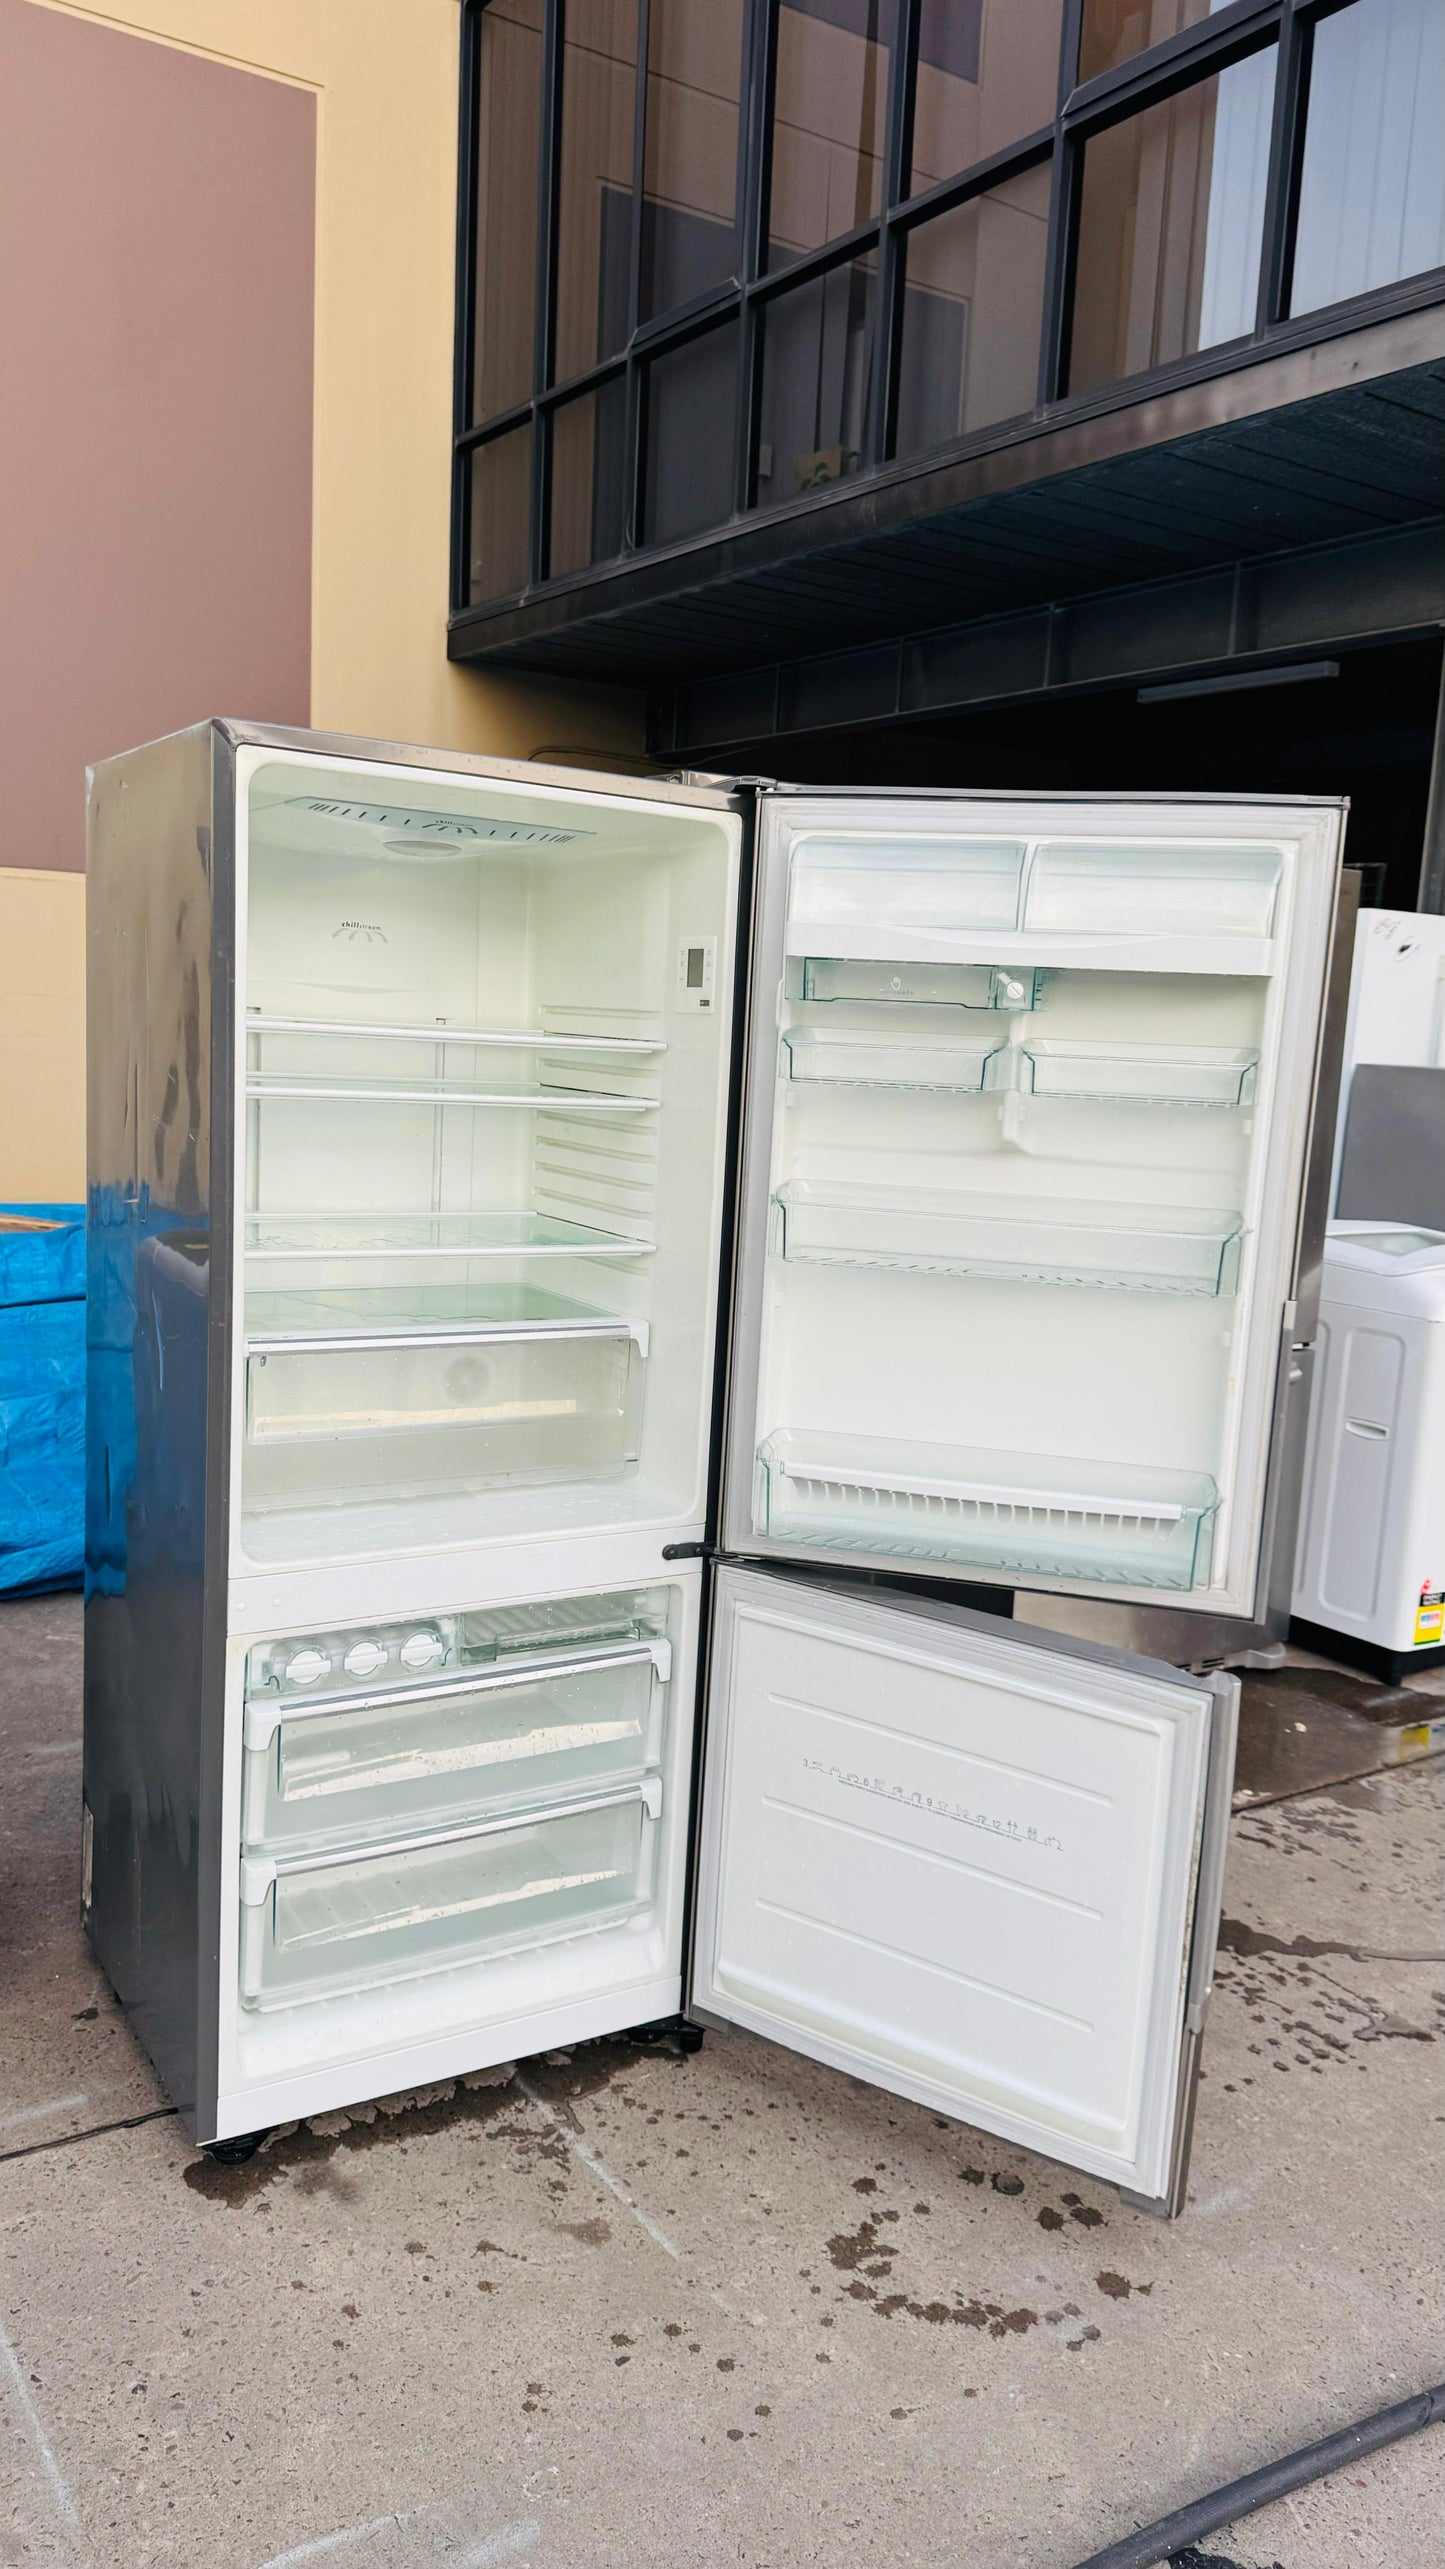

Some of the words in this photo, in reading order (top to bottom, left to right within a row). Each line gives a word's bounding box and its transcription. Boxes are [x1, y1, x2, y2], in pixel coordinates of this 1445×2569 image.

[803, 1758, 808, 1767] 3
[863, 1777, 870, 1786] 6
[927, 1798, 933, 1807] 9
[992, 1819, 1001, 1829] 12
